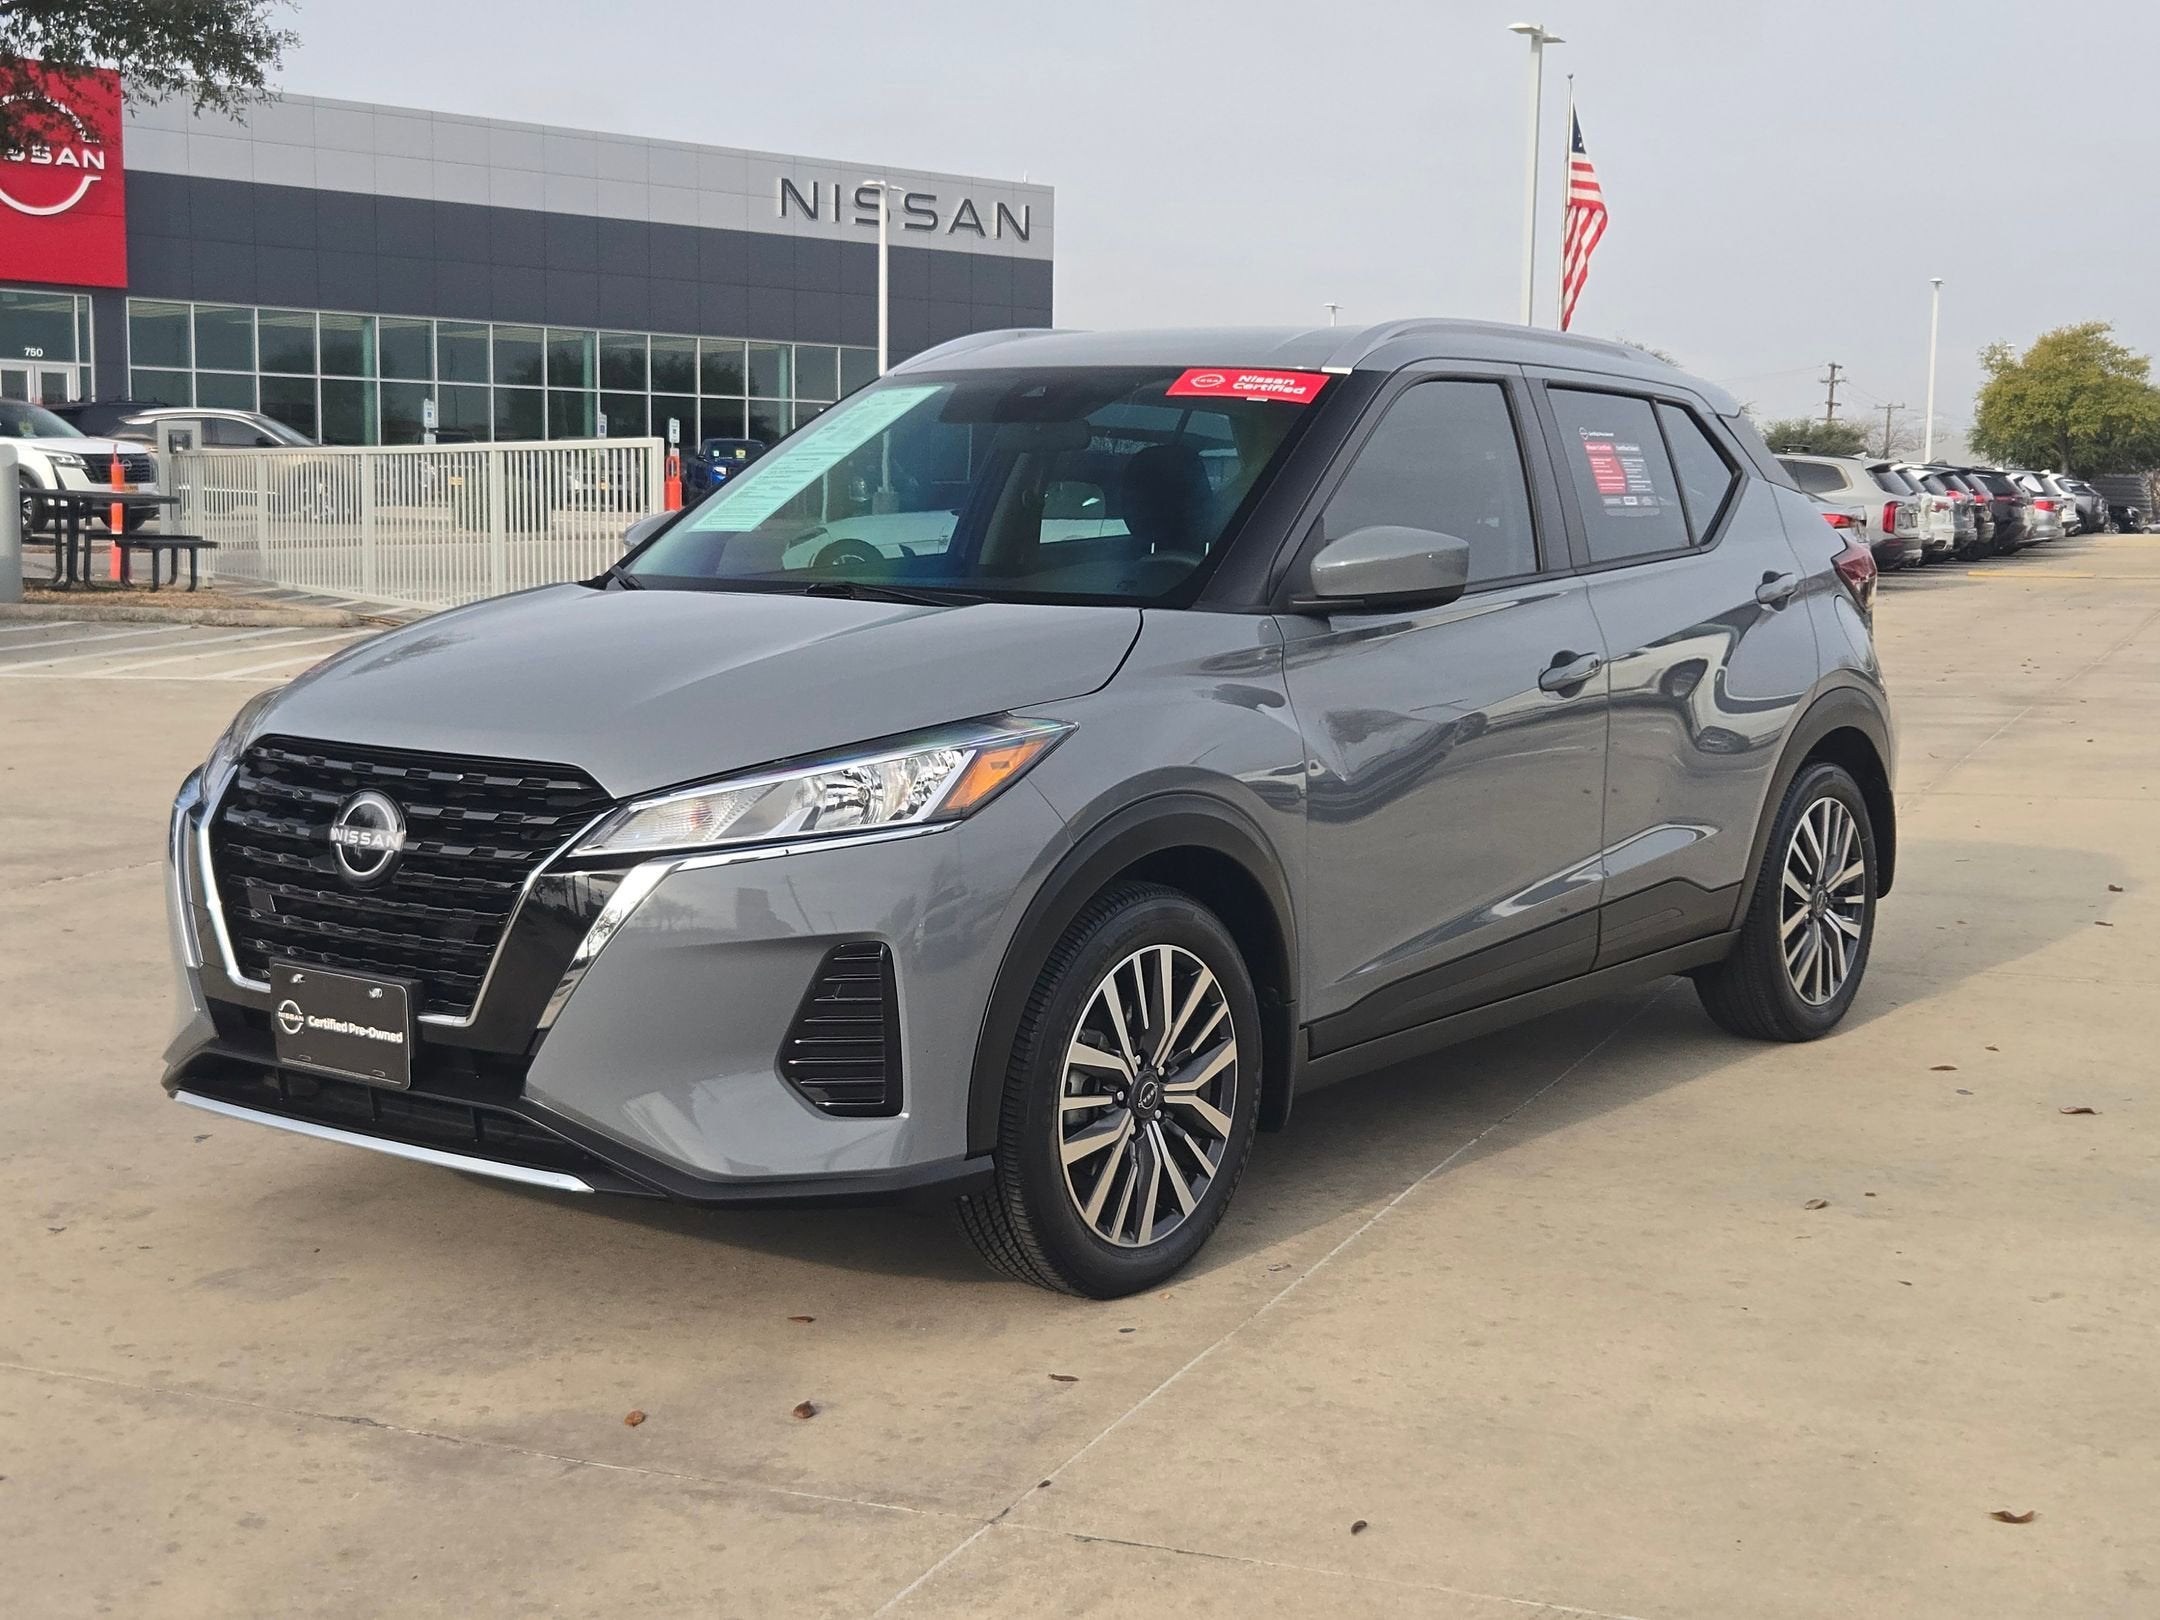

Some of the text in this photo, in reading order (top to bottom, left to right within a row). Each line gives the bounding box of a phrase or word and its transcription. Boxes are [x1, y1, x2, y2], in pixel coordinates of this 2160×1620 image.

[3, 144, 105, 169] SAN
[777, 177, 1030, 242] NISSAN
[24, 347, 43, 357] 750
[1232, 383, 1306, 394] Certified
[1238, 375, 1295, 384] Nissan
[330, 827, 404, 851] NISSAN
[277, 1011, 404, 1044] NISSAN Certified Pre-Owned
